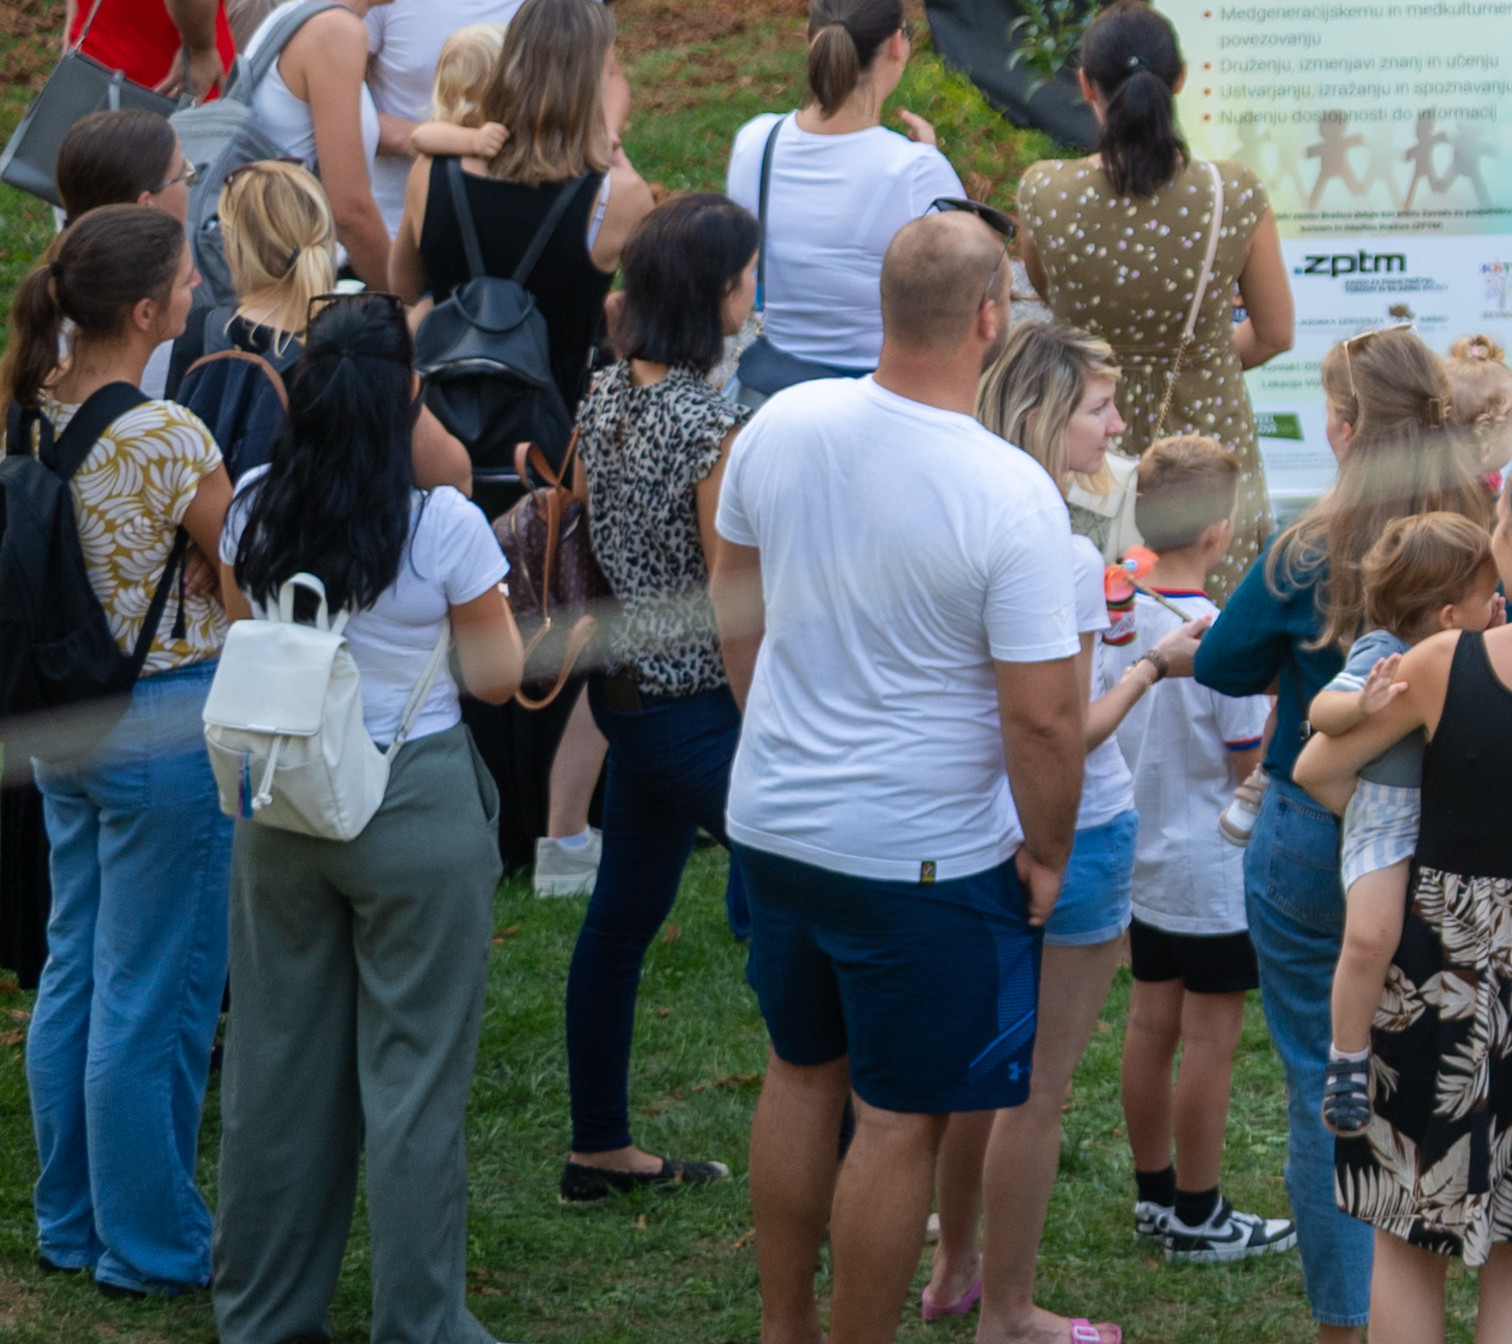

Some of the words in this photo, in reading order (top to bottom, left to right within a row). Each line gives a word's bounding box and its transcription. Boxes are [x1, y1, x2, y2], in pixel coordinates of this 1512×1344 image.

[1220, 3, 1384, 23] Medgeneracijskemu
[1388, 4, 1402, 17] in
[1220, 32, 1322, 50] povezovanju
[1299, 55, 1376, 74] izmenjavi
[1380, 55, 1423, 72] znanj
[1427, 55, 1442, 69] in
[1446, 52, 1500, 71] učenju
[1318, 81, 1391, 100] izražanju
